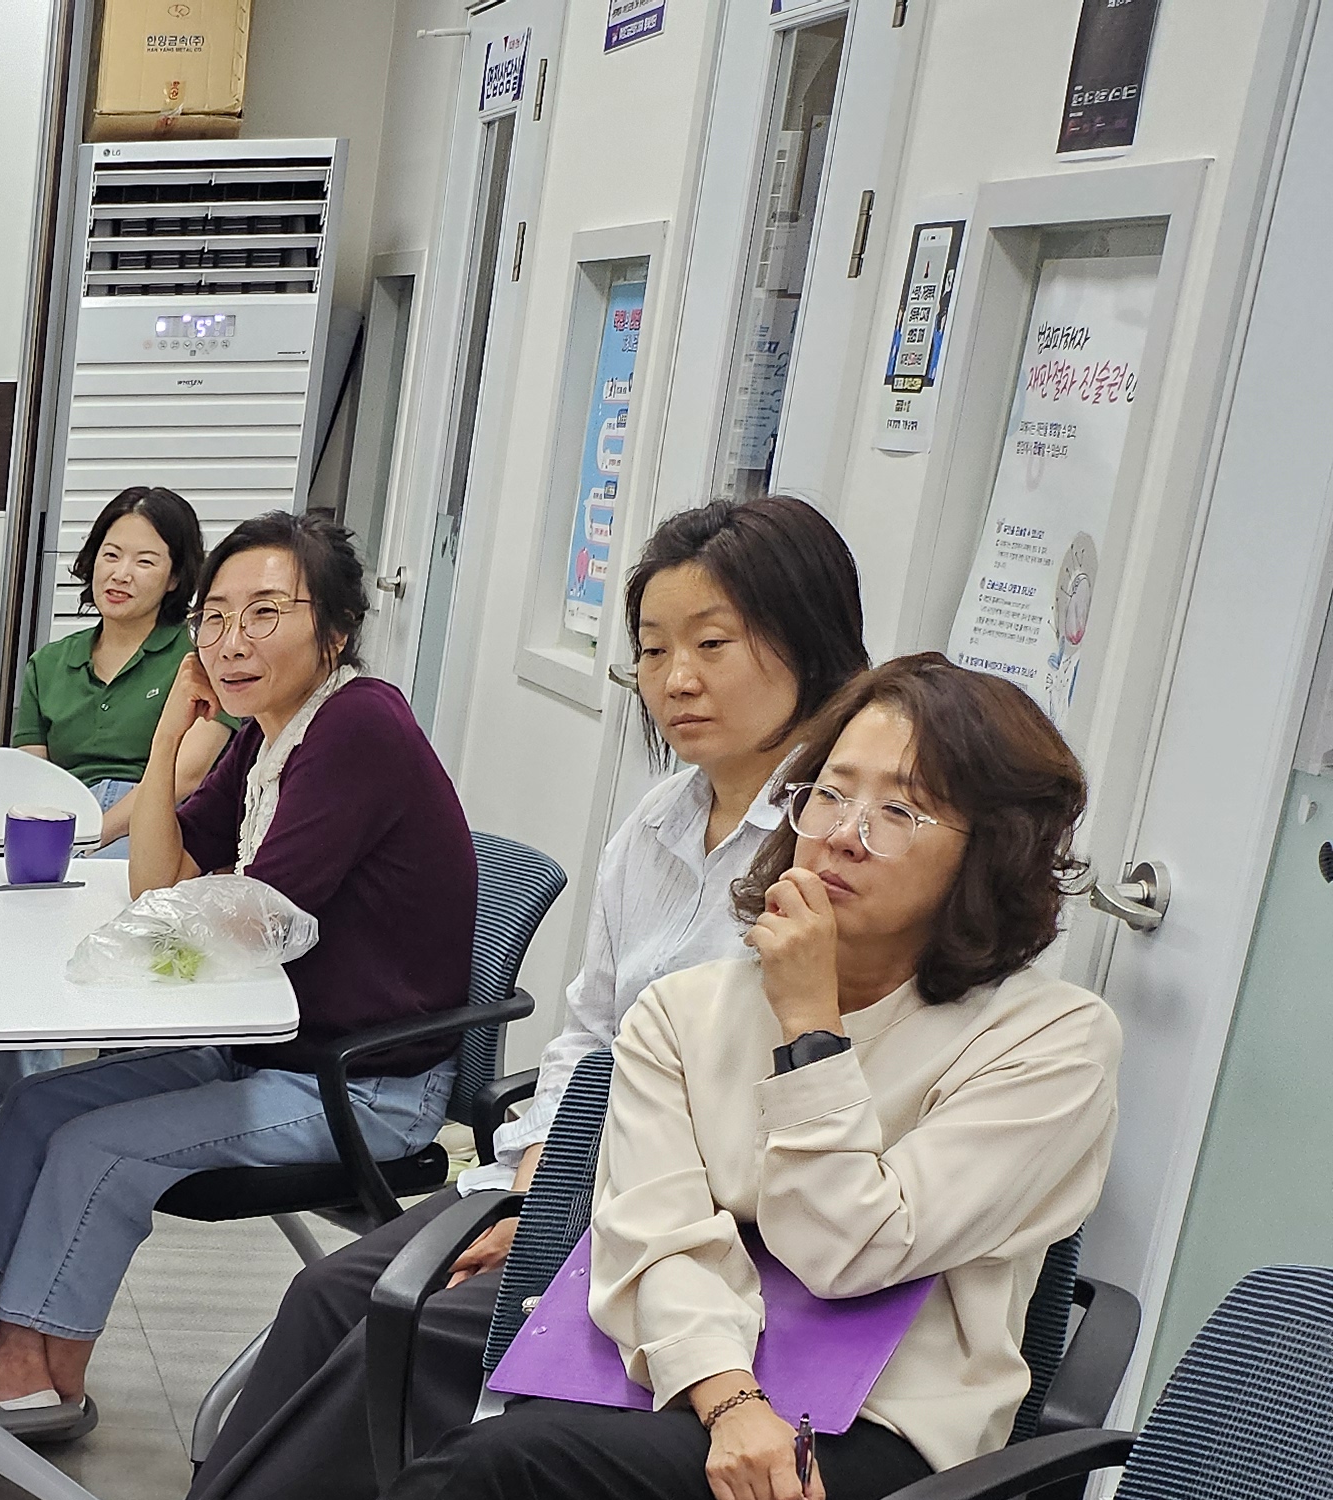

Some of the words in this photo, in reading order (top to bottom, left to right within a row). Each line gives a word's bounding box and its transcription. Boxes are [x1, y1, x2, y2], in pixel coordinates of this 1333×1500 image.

[147, 35, 205, 46] 한양금속(주)
[1037, 321, 1091, 354] 범죄피해자
[1026, 359, 1077, 401] 재판절차
[1079, 360, 1129, 405] 진술권
